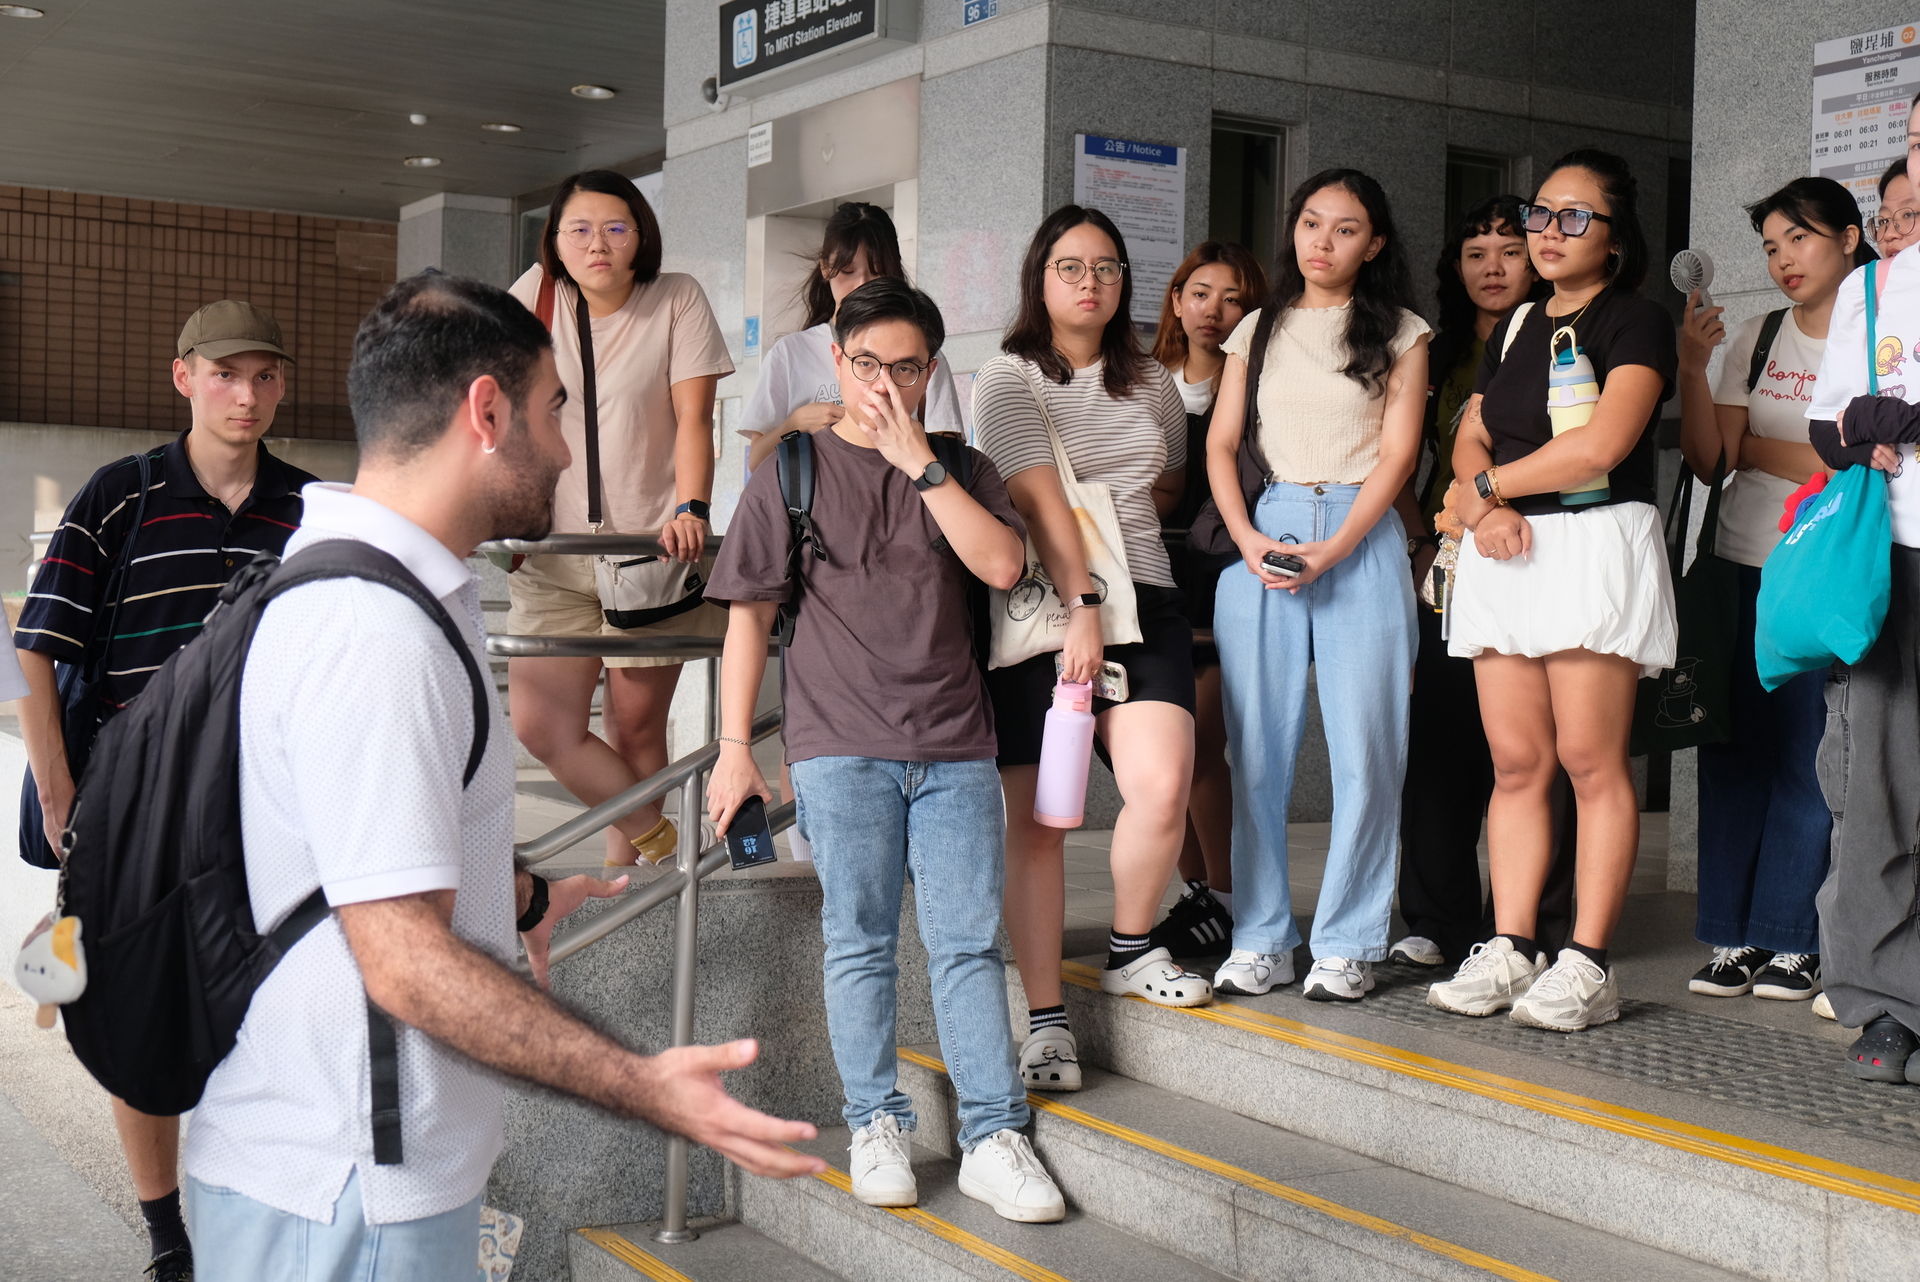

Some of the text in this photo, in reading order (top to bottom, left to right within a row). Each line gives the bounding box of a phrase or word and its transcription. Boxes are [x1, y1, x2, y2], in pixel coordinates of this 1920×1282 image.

[968, 4, 980, 22] 96
[764, 11, 863, 57] To MRT Station Elevator
[1850, 31, 1894, 55] 鹽埕埔
[1862, 51, 1902, 65] Yanchengpu
[1865, 67, 1898, 82] 服務時間
[1834, 129, 1852, 139] 06:01
[1859, 124, 1879, 134] 06:03
[1888, 119, 1907, 129] 06:01
[1104, 140, 1125, 153] 公告
[1132, 144, 1162, 157] Notice
[1833, 144, 1852, 154] 00:01
[1859, 139, 1878, 149] 00:21
[1887, 134, 1906, 145] 00:01
[1759, 388, 1797, 401] mon
